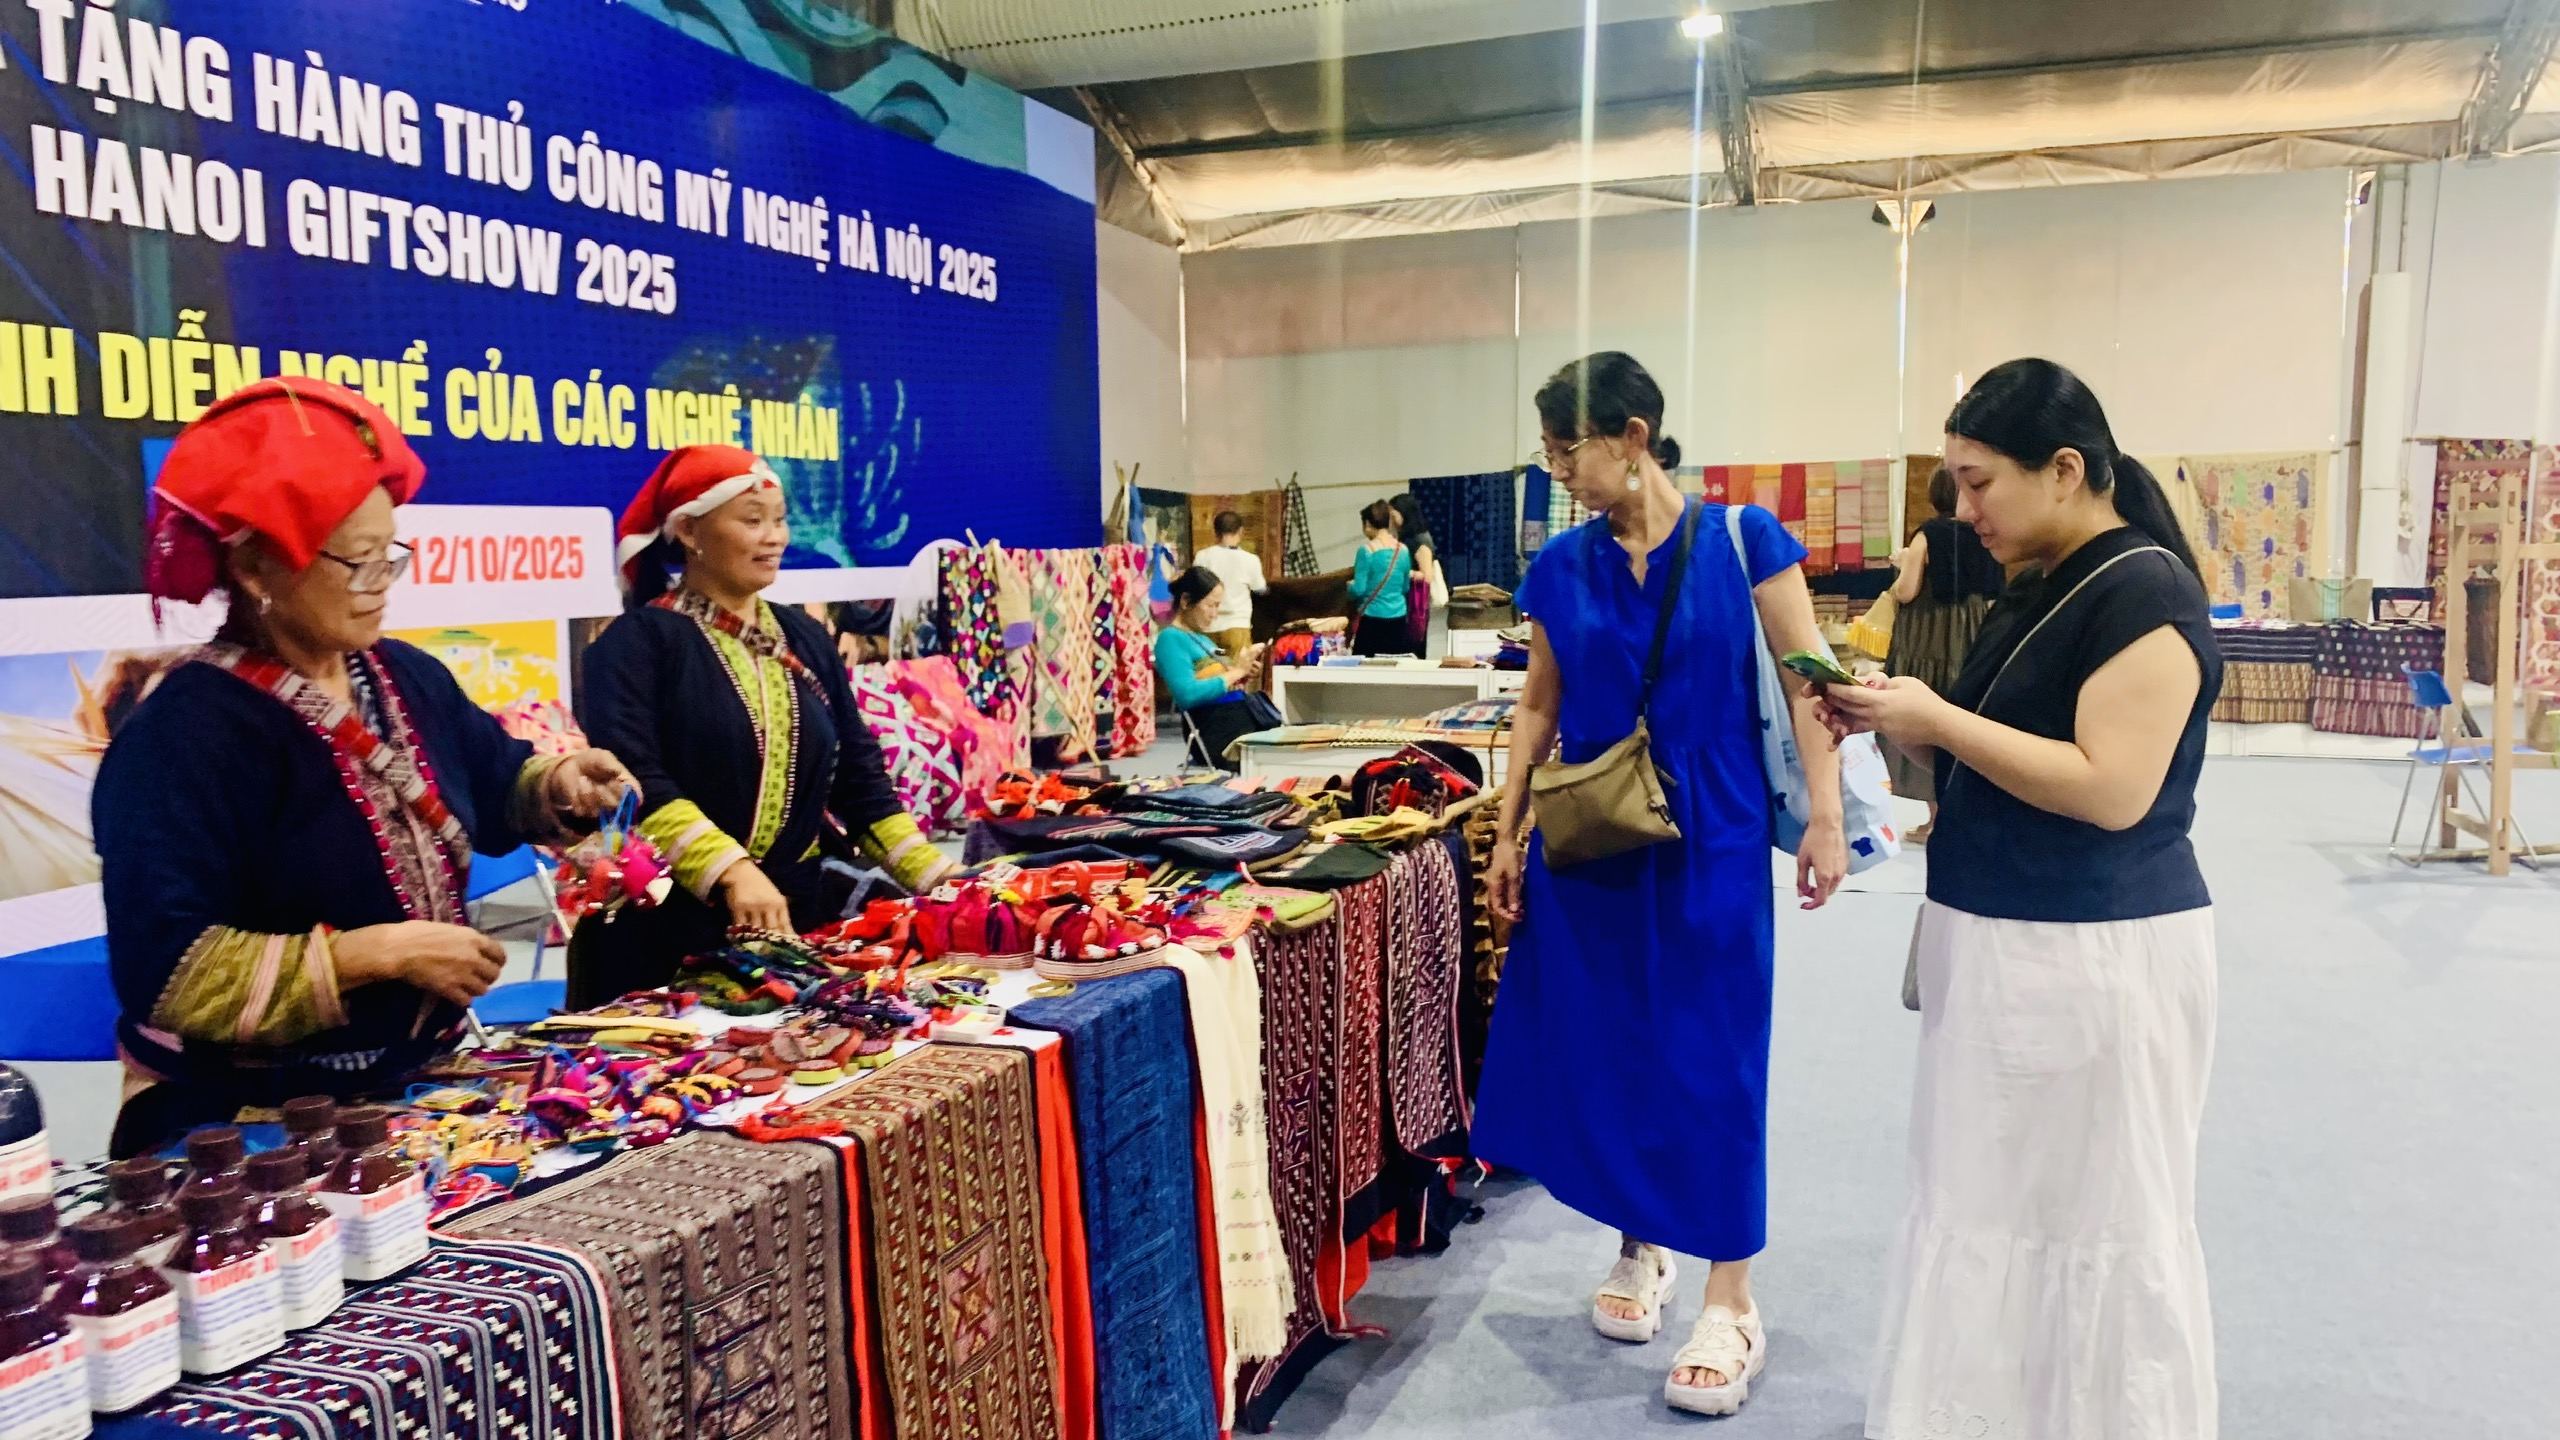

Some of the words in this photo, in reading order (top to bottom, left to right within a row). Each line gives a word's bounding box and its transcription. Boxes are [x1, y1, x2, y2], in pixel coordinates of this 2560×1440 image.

[30, 124, 266, 248] HANOI
[286, 178, 562, 295] GIFTSHOW
[575, 238, 677, 315] 2025
[253, 50, 422, 167] HÀNG
[435, 100, 533, 191] THỦ
[546, 130, 664, 223] CÔNG
[675, 167, 732, 237] MỸ
[742, 187, 831, 273] NGHỆ
[838, 209, 880, 273] HÀ
[885, 223, 933, 295] NỘI
[939, 244, 997, 302] 2025
[98, 309, 260, 423] DIỄN
[445, 347, 543, 443] CỦA
[552, 369, 636, 449] CÁC
[750, 392, 839, 461] NHÂN
[409, 535, 584, 585] 12/10/2025
